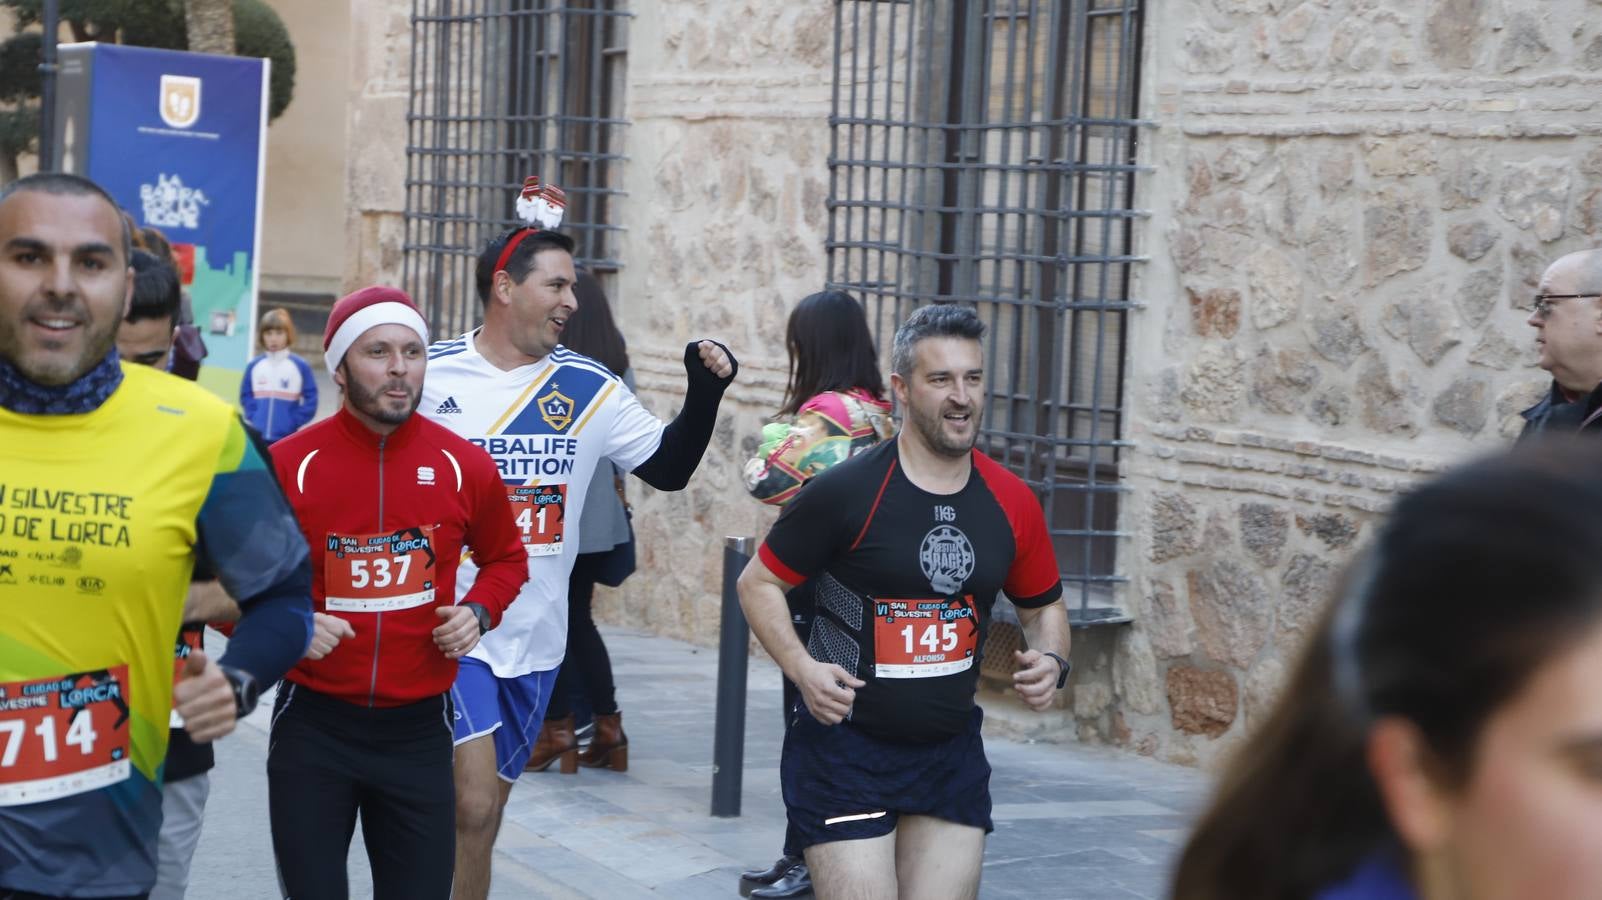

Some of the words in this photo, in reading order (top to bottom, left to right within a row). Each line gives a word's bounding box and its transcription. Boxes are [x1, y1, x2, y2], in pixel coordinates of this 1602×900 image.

[548, 405, 567, 415] LA
[10, 487, 133, 520] SILVESTRE
[13, 515, 42, 541] DE
[50, 517, 130, 547] LORCA
[328, 538, 338, 550] VI
[341, 537, 357, 545] SAN
[345, 544, 384, 553] SILVESTRE
[391, 538, 428, 553] LORCA
[350, 554, 411, 588] 537
[877, 604, 887, 615] VI
[891, 602, 907, 610] SAN
[894, 610, 932, 618] SILVESTRE
[940, 607, 973, 620] LORCA
[901, 622, 958, 654] 145
[913, 653, 945, 663] ALFONSO
[24, 682, 60, 696] CIUDAD
[61, 679, 74, 691] DE
[60, 684, 119, 708] LORCA
[0, 708, 98, 768] 714
